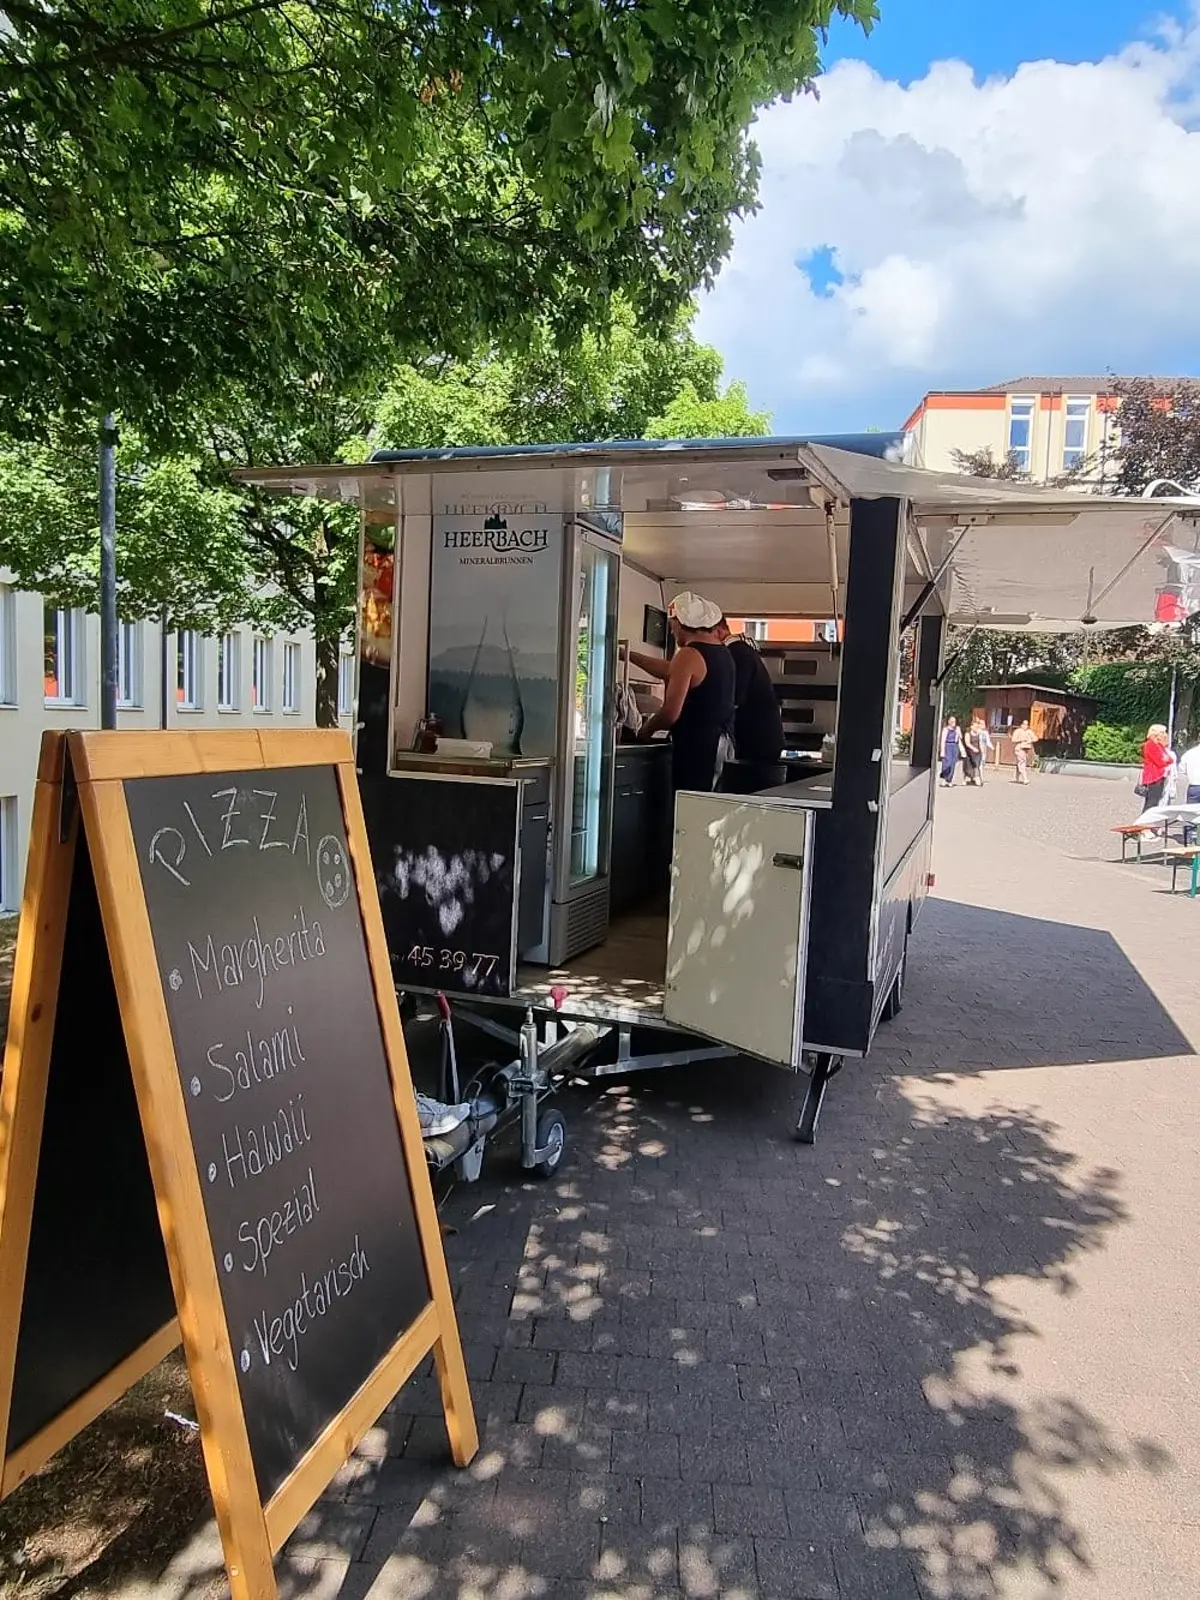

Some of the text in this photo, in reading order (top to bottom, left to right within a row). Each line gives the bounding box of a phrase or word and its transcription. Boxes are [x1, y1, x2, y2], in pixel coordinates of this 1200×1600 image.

[443, 529, 549, 552] HEERBACH
[459, 556, 534, 566] MINERALBRUNNEN
[150, 786, 311, 886] PIZZA
[187, 906, 327, 1009] Margherita
[407, 945, 434, 968] 45
[439, 948, 466, 972] 39
[472, 952, 500, 977] 77
[207, 1005, 306, 1102] Salami
[222, 1093, 312, 1188] Hawaii
[238, 1167, 320, 1278] Spezial
[253, 1234, 371, 1372] Vegetarisch
